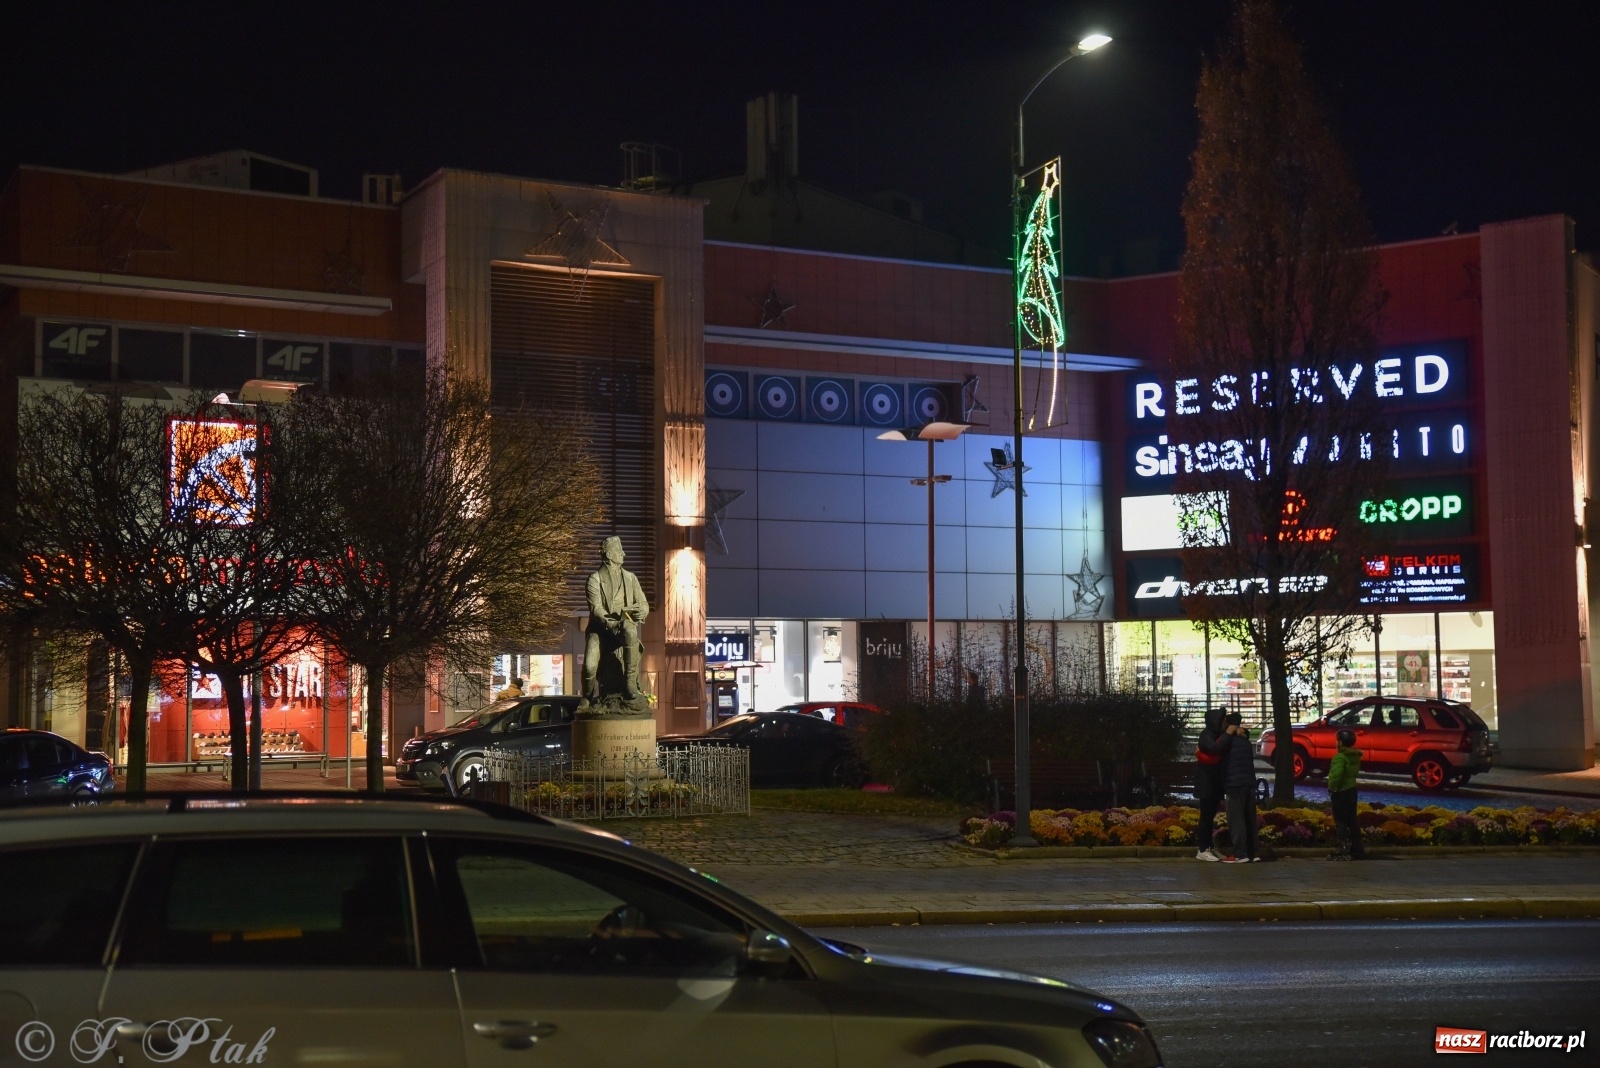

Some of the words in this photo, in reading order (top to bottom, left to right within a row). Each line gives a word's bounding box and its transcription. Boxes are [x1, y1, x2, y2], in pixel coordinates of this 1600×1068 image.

[49, 326, 107, 355] 4F
[267, 344, 319, 371] 4F
[1360, 495, 1462, 523] CROPP
[705, 636, 744, 661] briju
[866, 637, 902, 659] briju
[269, 661, 322, 698] STAR
